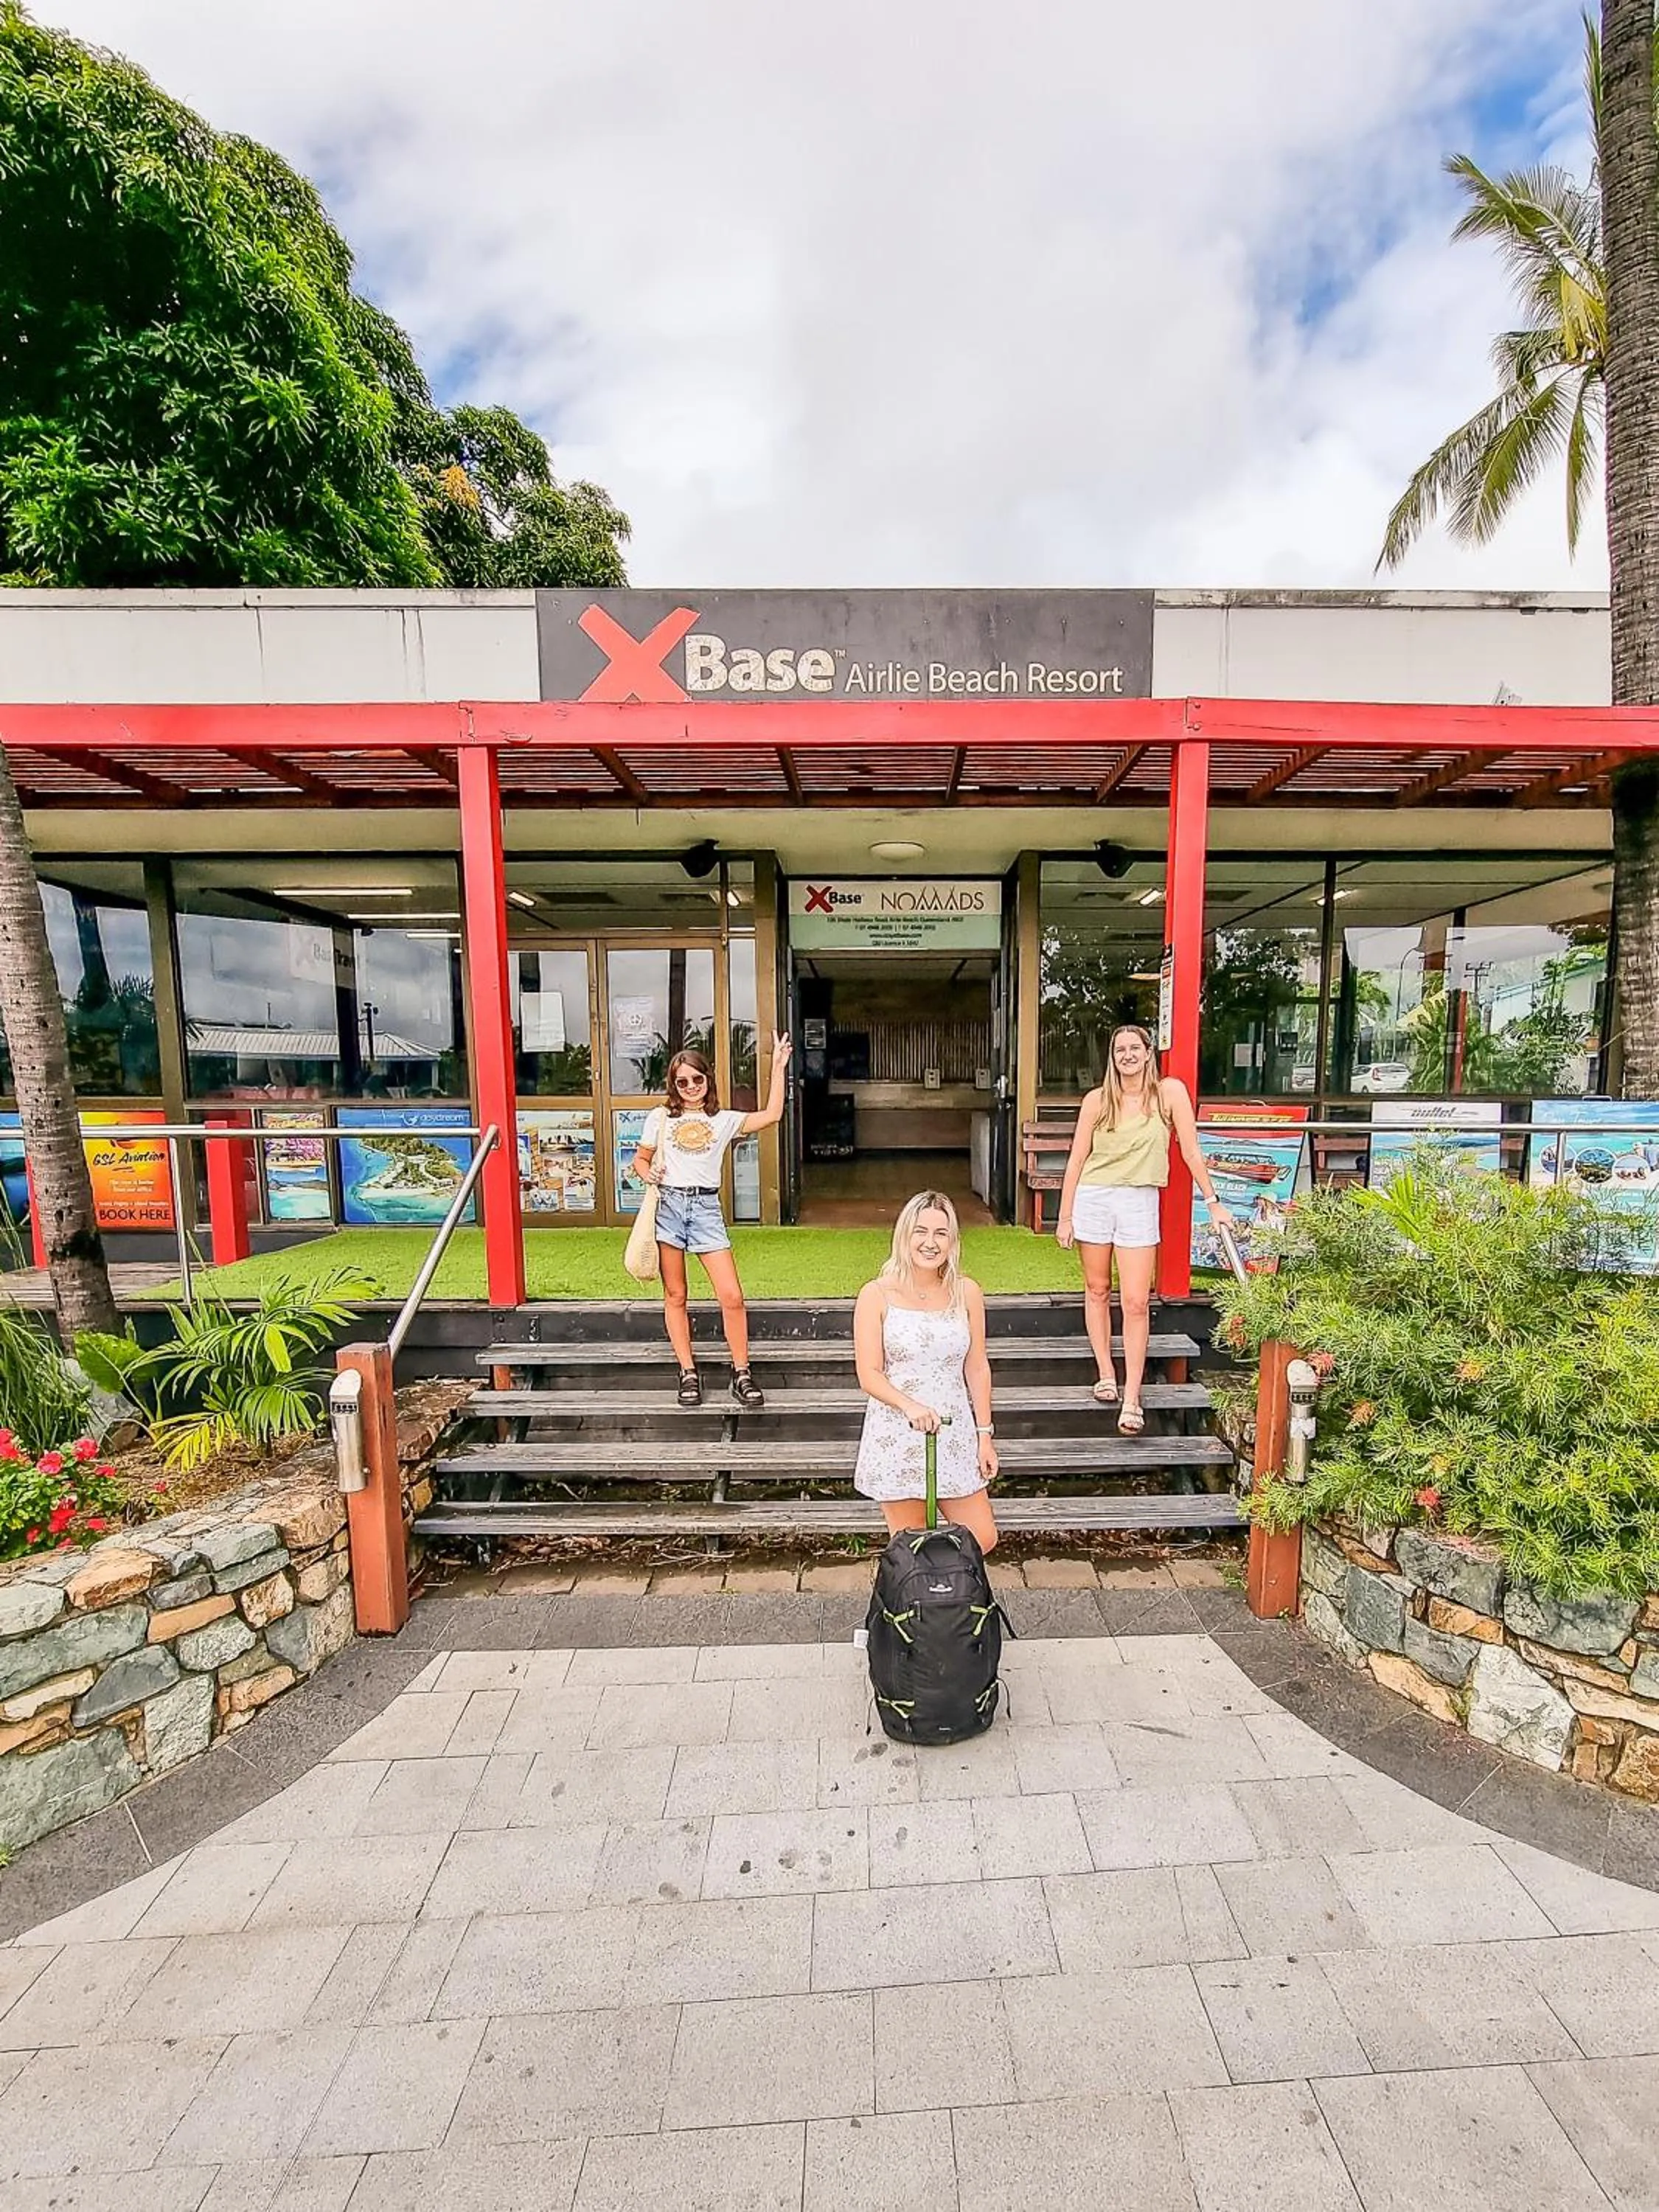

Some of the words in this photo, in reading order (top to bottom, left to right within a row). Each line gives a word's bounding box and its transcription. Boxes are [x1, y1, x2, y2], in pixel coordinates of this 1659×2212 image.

[685, 634, 836, 692] Base
[844, 662, 921, 694] Airlie
[928, 662, 1019, 694] Beach
[1026, 662, 1124, 694] Resort
[828, 891, 862, 904] Base
[881, 886, 985, 911] NOMADS
[99, 1208, 137, 1220] BOOK
[139, 1208, 172, 1220] HERE
